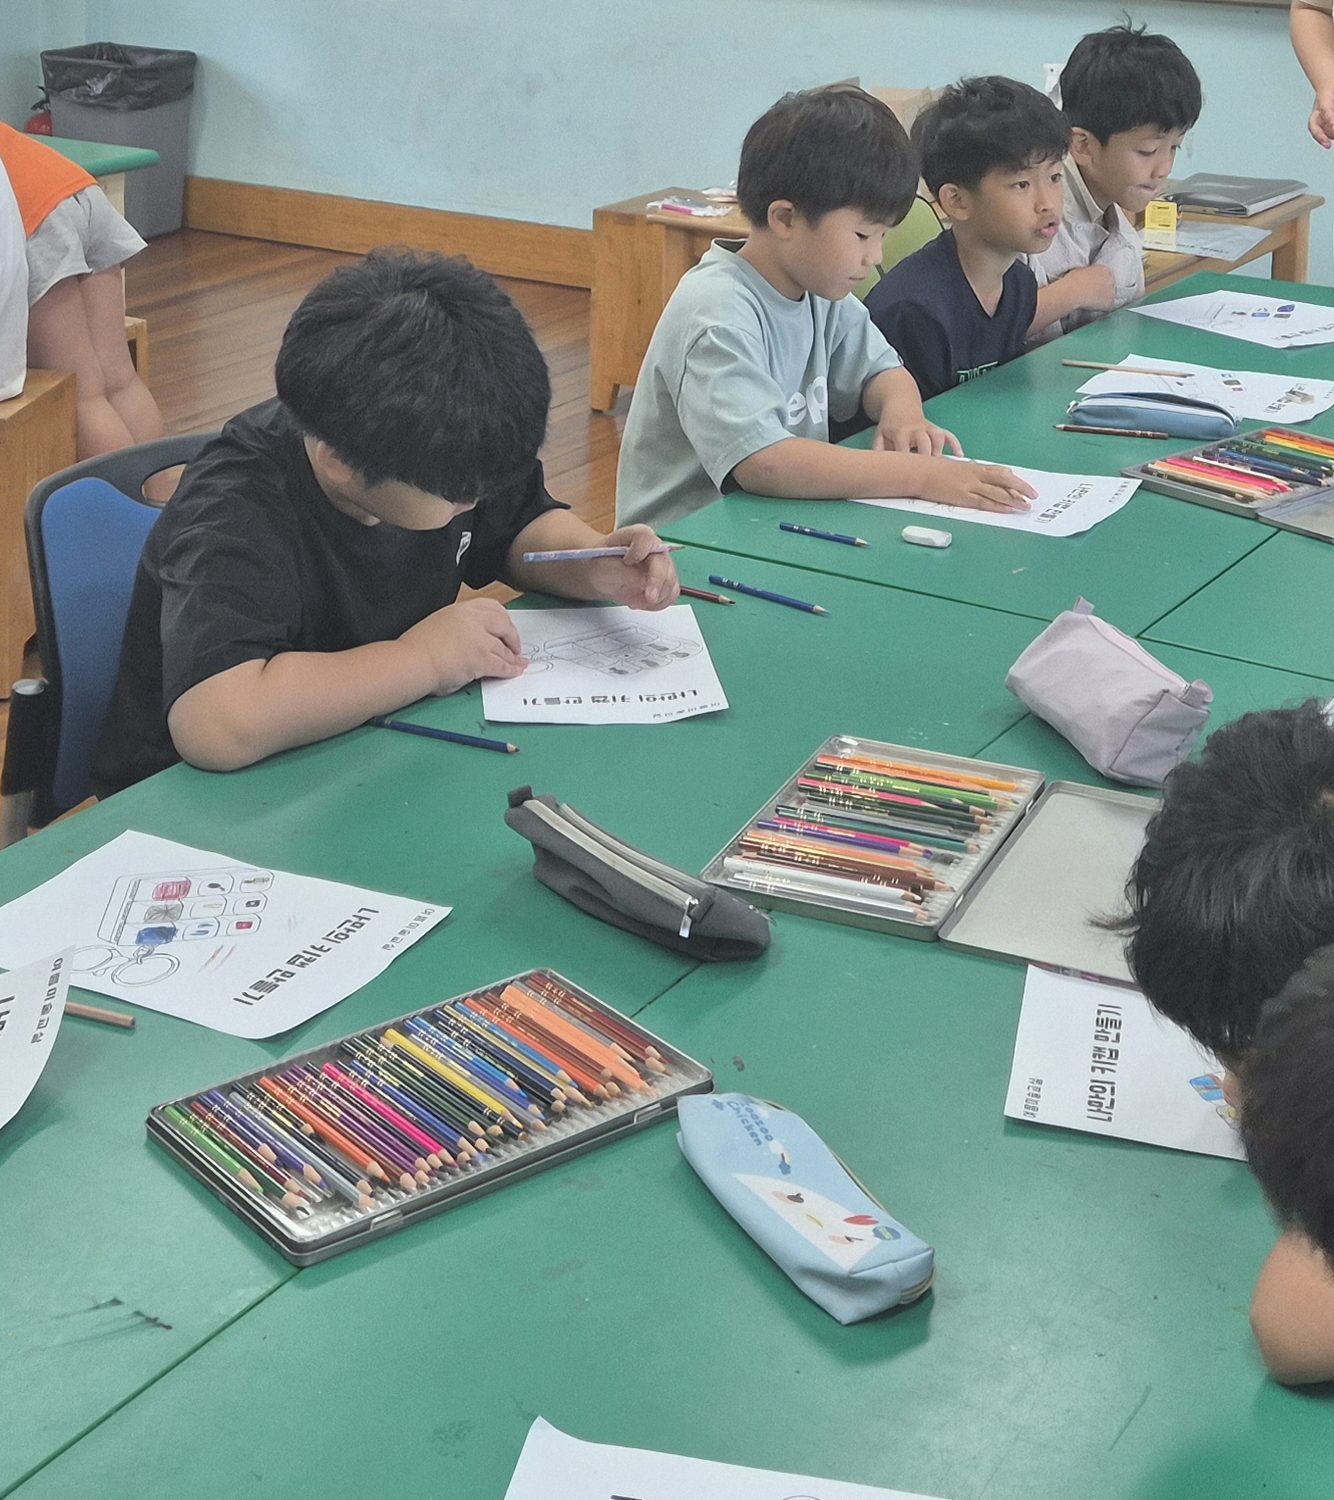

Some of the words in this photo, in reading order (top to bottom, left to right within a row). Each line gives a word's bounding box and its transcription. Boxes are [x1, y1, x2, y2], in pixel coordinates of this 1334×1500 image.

[321, 906, 380, 945] 나만의
[285, 943, 333, 969] 키캡
[30, 956, 64, 1045] 여름미술교실
[232, 967, 297, 1006] 만들기
[1093, 1003, 1123, 1044] 만들기
[1090, 1045, 1120, 1075] 키캡
[1086, 1078, 1117, 1123] 나만의
[727, 1100, 763, 1146] Chicken
